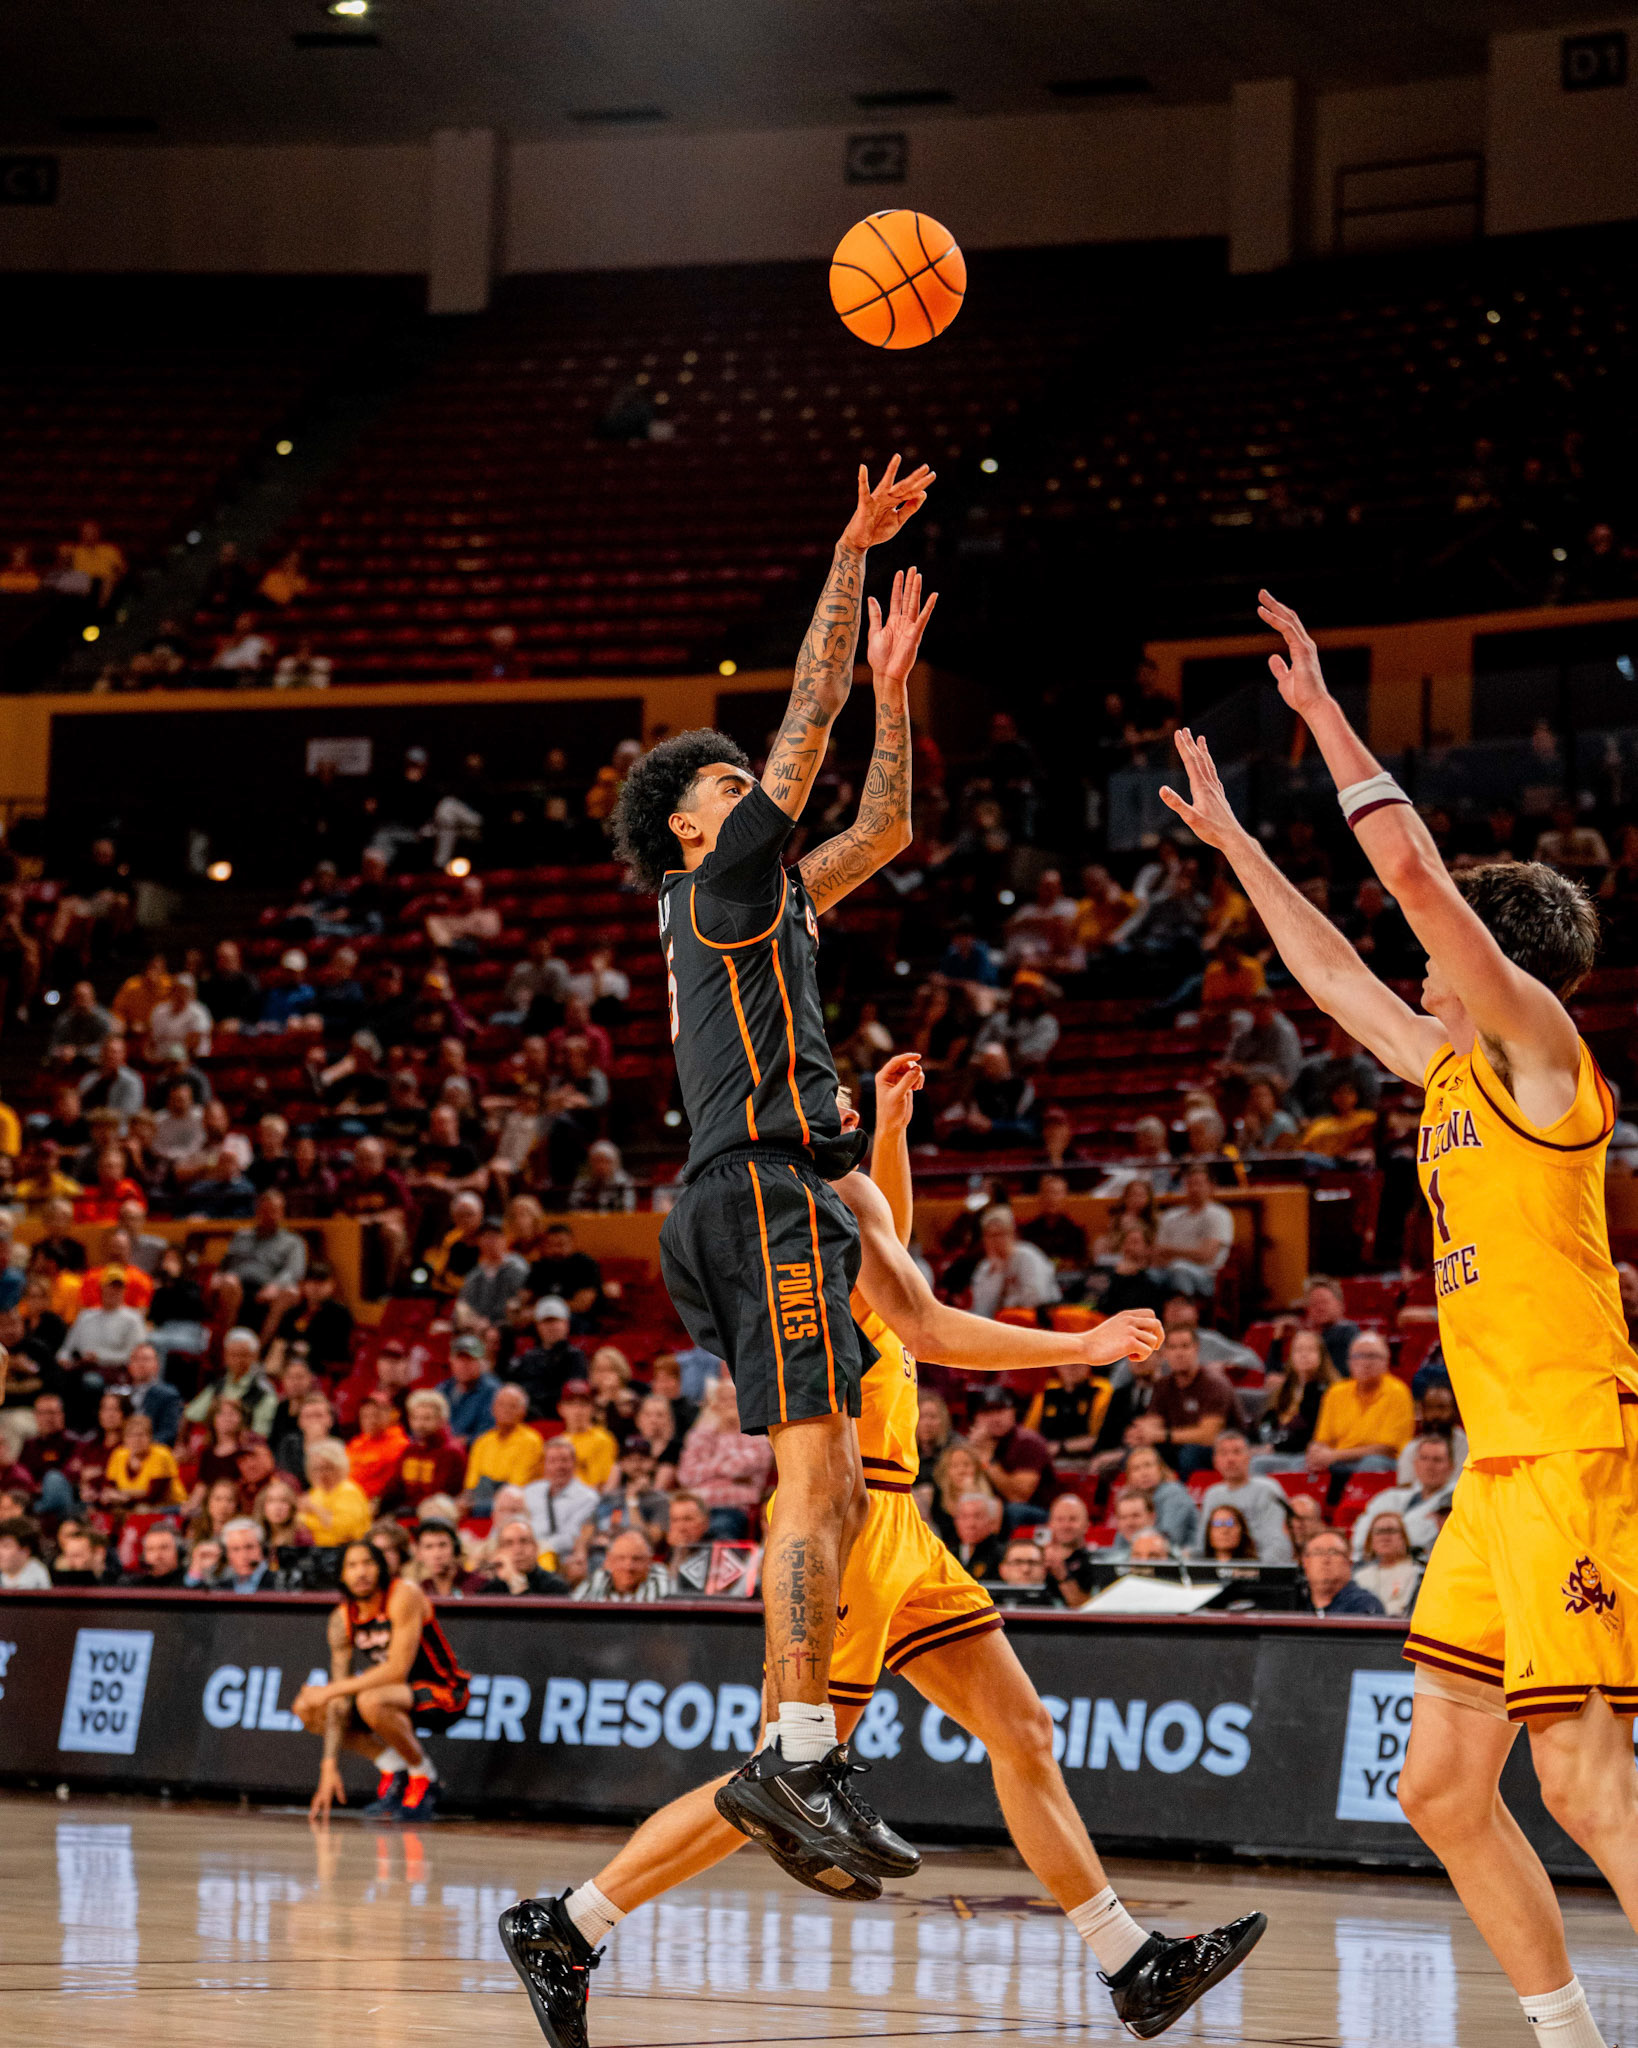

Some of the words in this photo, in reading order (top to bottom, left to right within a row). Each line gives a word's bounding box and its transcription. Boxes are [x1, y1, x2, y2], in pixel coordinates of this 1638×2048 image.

[1570, 44, 1619, 80] D1
[771, 761, 803, 782] TIME
[771, 782, 791, 801] MY
[1428, 1169, 1451, 1243] 1
[776, 1262, 819, 1341] POKES
[89, 1650, 138, 1674] YOU
[90, 1680, 124, 1702] DO
[1371, 1694, 1413, 1723] YO
[79, 1710, 128, 1734] YOU
[538, 1676, 762, 1753] RESOR
[855, 1688, 904, 1759] &
[919, 1694, 1253, 1777] CSINOS
